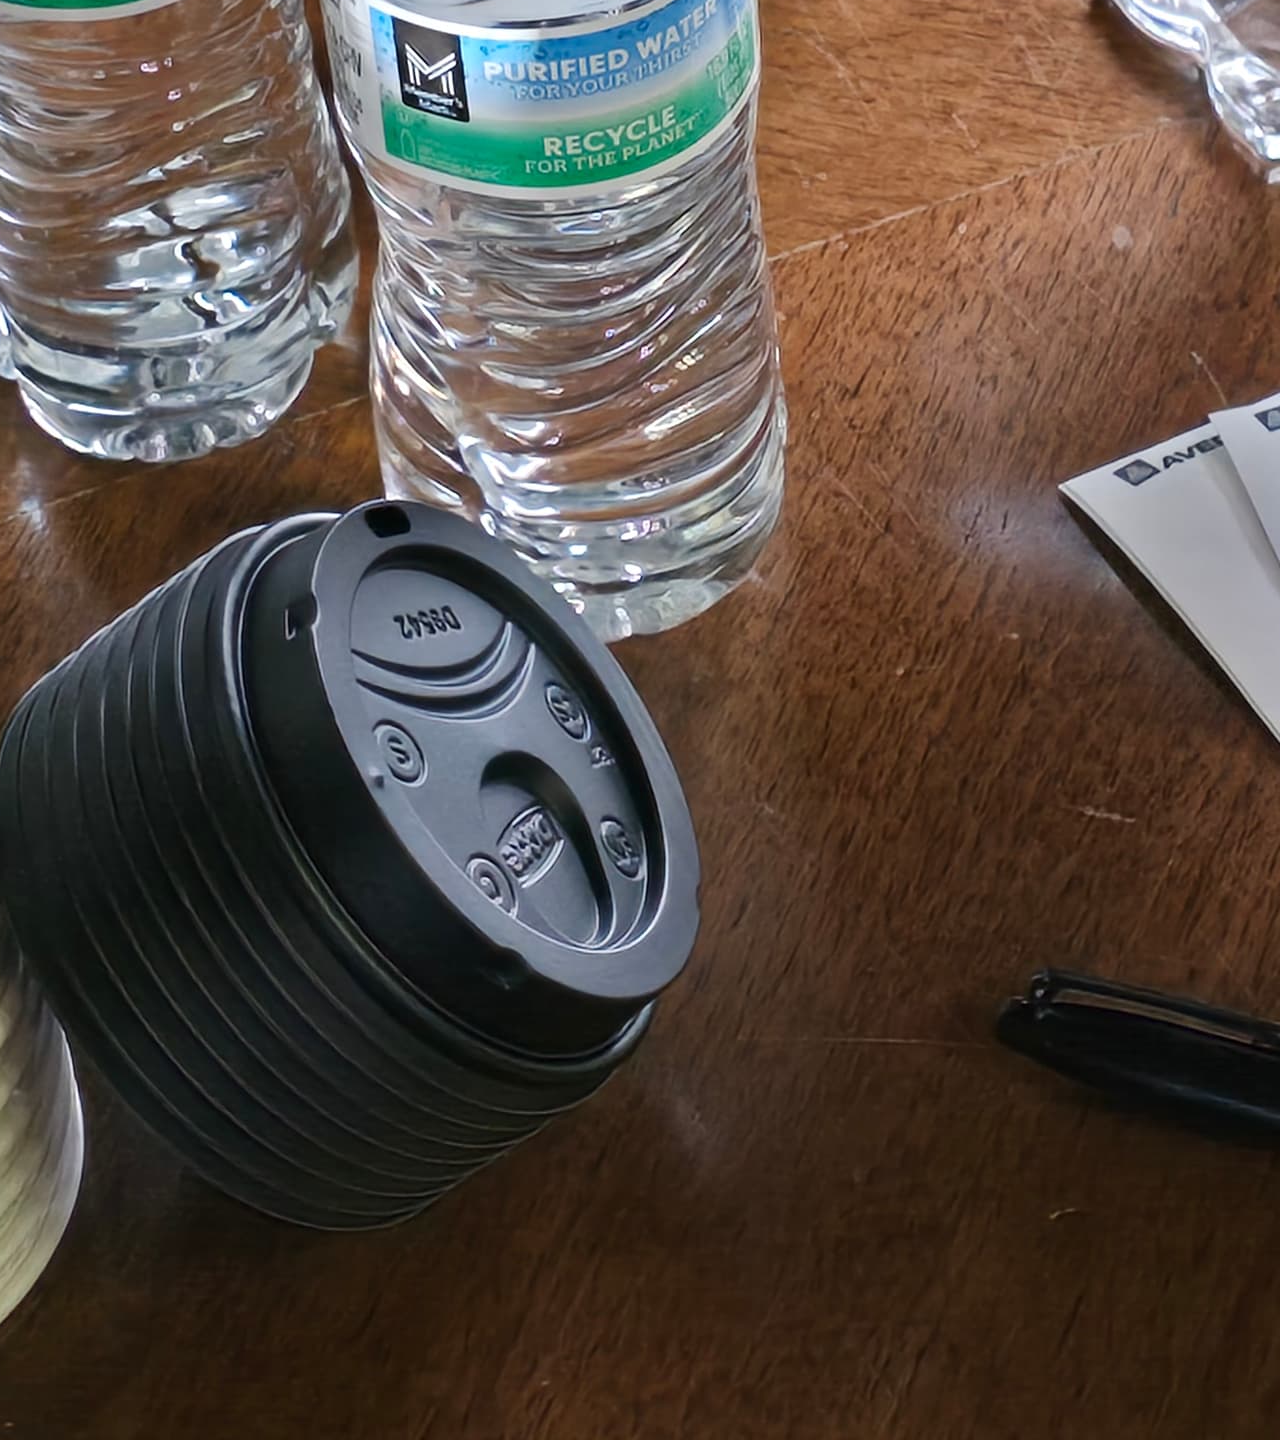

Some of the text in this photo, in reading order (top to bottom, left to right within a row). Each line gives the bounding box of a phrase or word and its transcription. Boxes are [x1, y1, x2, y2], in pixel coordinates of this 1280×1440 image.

[483, 49, 630, 83] PURIFIED
[511, 34, 702, 102] FOR YOUR THIRST
[525, 119, 696, 175] FOR THE PLANET
[543, 105, 676, 157] RECYCLE
